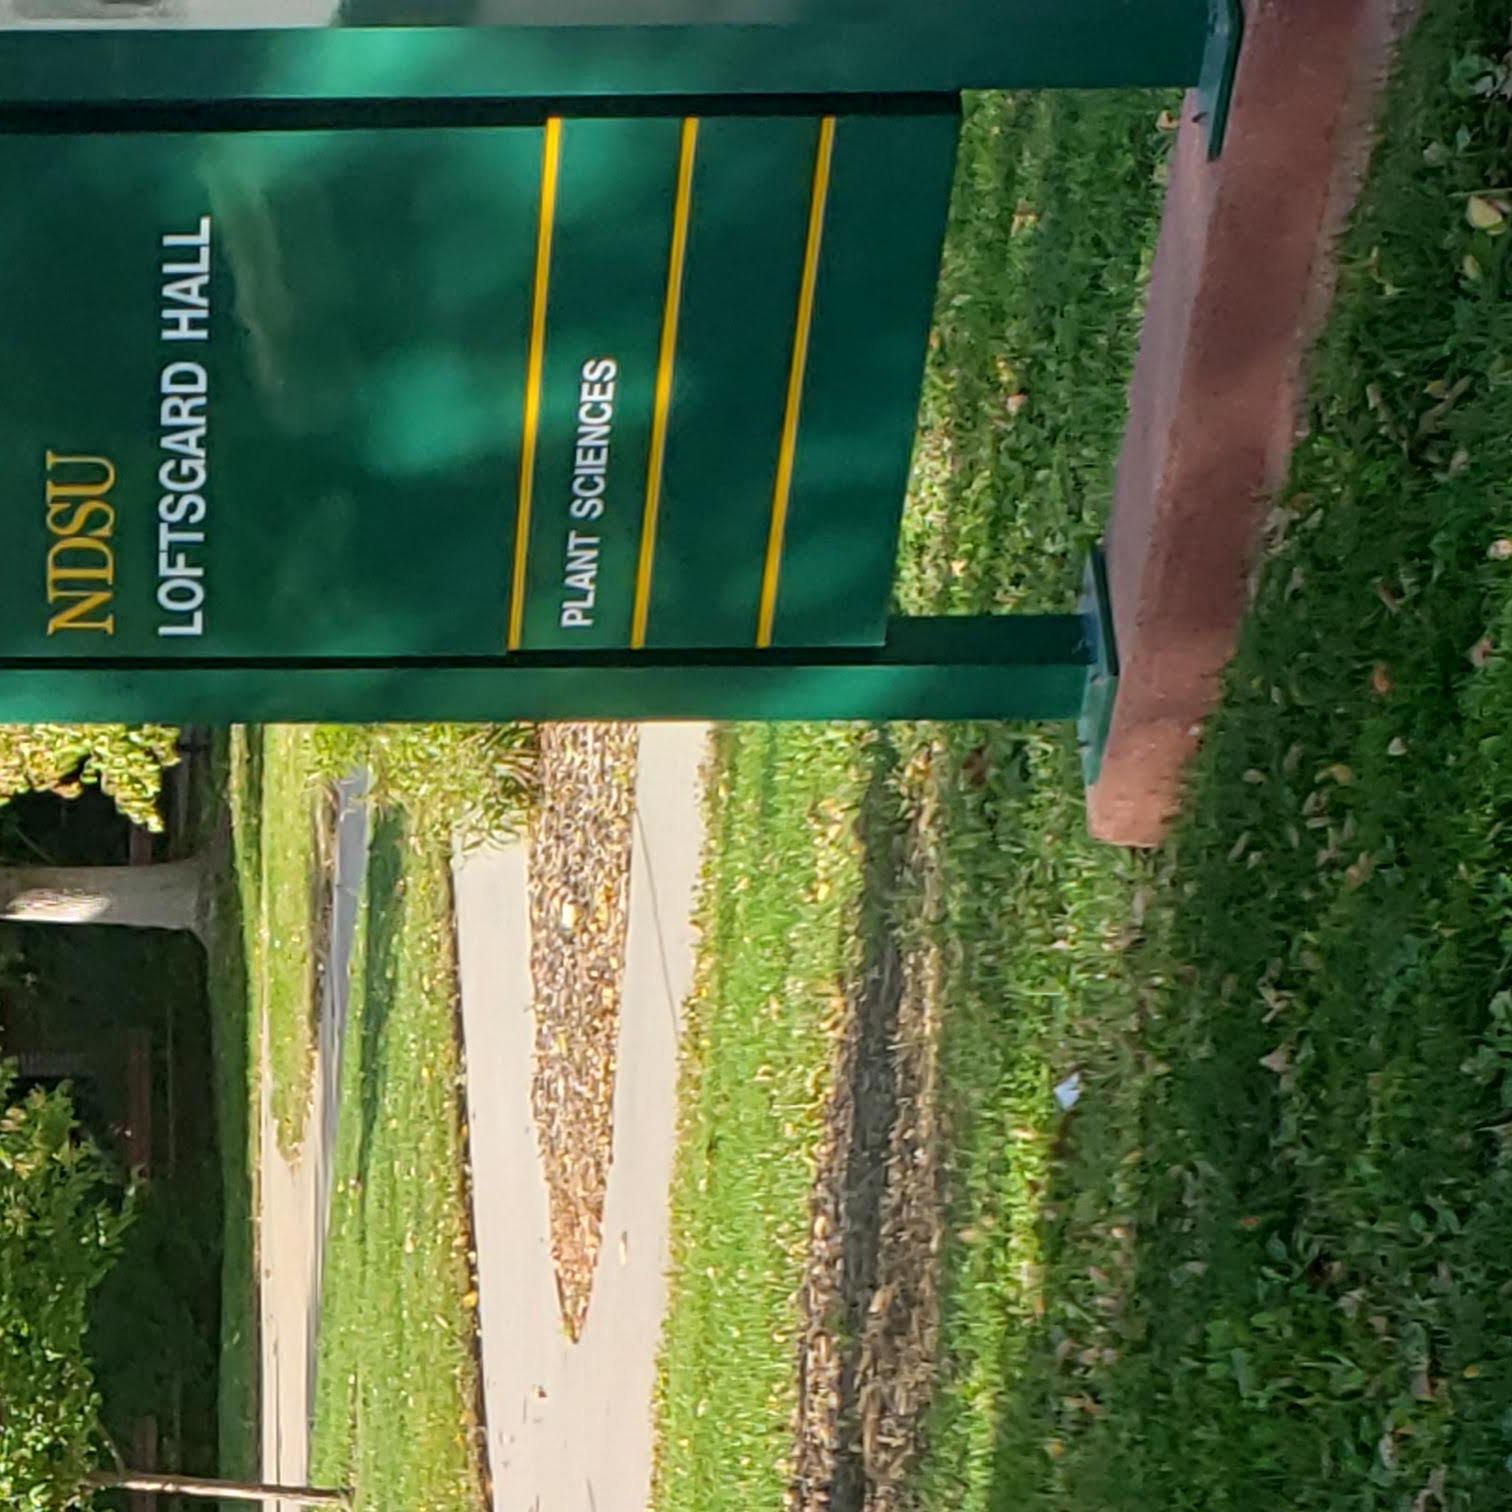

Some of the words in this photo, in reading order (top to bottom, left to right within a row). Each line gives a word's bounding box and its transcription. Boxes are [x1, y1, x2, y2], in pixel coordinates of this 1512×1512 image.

[161, 216, 212, 340] HALL
[156, 361, 208, 636] LOFTSGARD
[569, 358, 618, 519] SCIENCES
[45, 450, 116, 636] NDSU
[560, 530, 600, 628] PLANT
